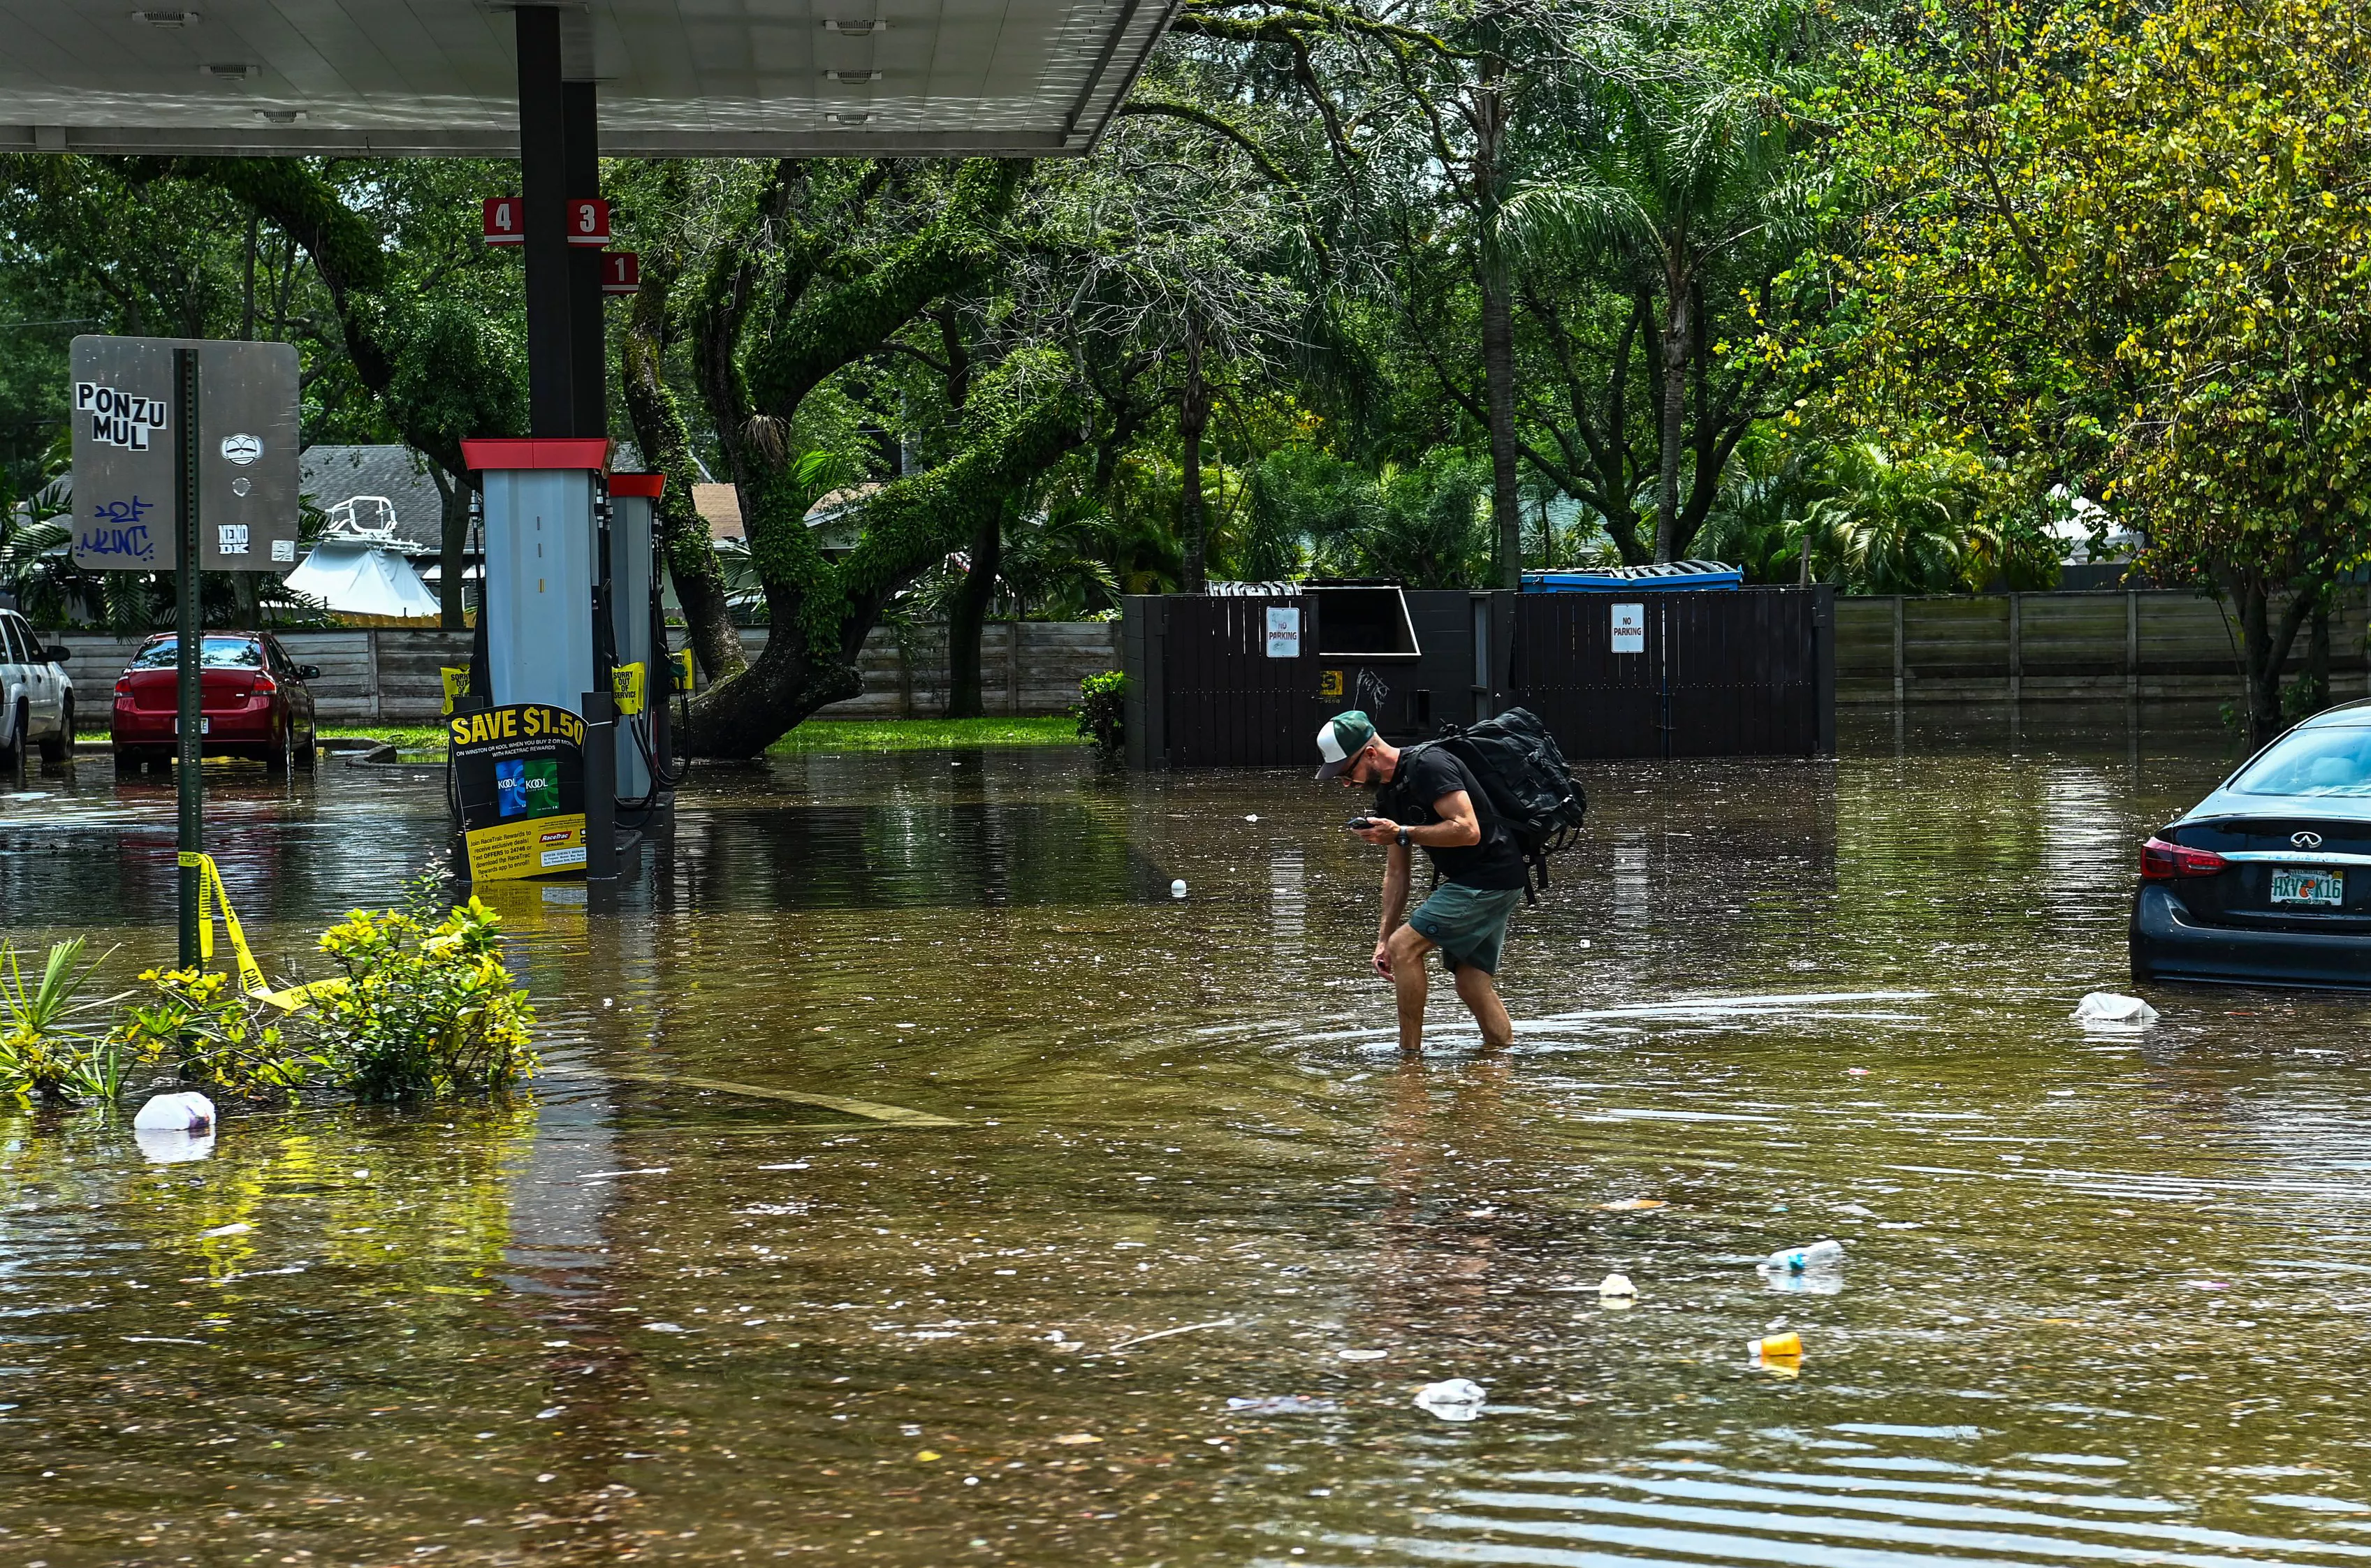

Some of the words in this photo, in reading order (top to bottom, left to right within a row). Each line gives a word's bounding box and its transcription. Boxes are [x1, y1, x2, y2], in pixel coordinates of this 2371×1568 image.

[495, 203, 511, 231] 4
[579, 204, 595, 233] 3
[615, 257, 625, 281] 1
[78, 383, 165, 427] PONZU
[93, 415, 147, 450] MUL
[1622, 617, 1632, 625] NO
[1269, 631, 1297, 640] PARKING
[1614, 627, 1642, 636] PARKING
[613, 671, 633, 679] SORRY
[614, 691, 636, 699] SERVICE
[451, 709, 518, 745] SAVE
[523, 706, 584, 745] $1.50
[497, 777, 518, 790] KOOL
[525, 777, 548, 790] KOOL
[481, 835, 502, 844] RaceTrac
[503, 831, 525, 840] Rewards
[541, 833, 569, 842] RaceTrac
[491, 841, 513, 850] exclusive
[476, 858, 498, 868] download
[507, 853, 531, 861] RaceTrac
[483, 850, 503, 858] OFFERS
[478, 866, 497, 875] Rewards
[2273, 877, 2300, 897] HXV
[2314, 877, 2341, 898] K16
